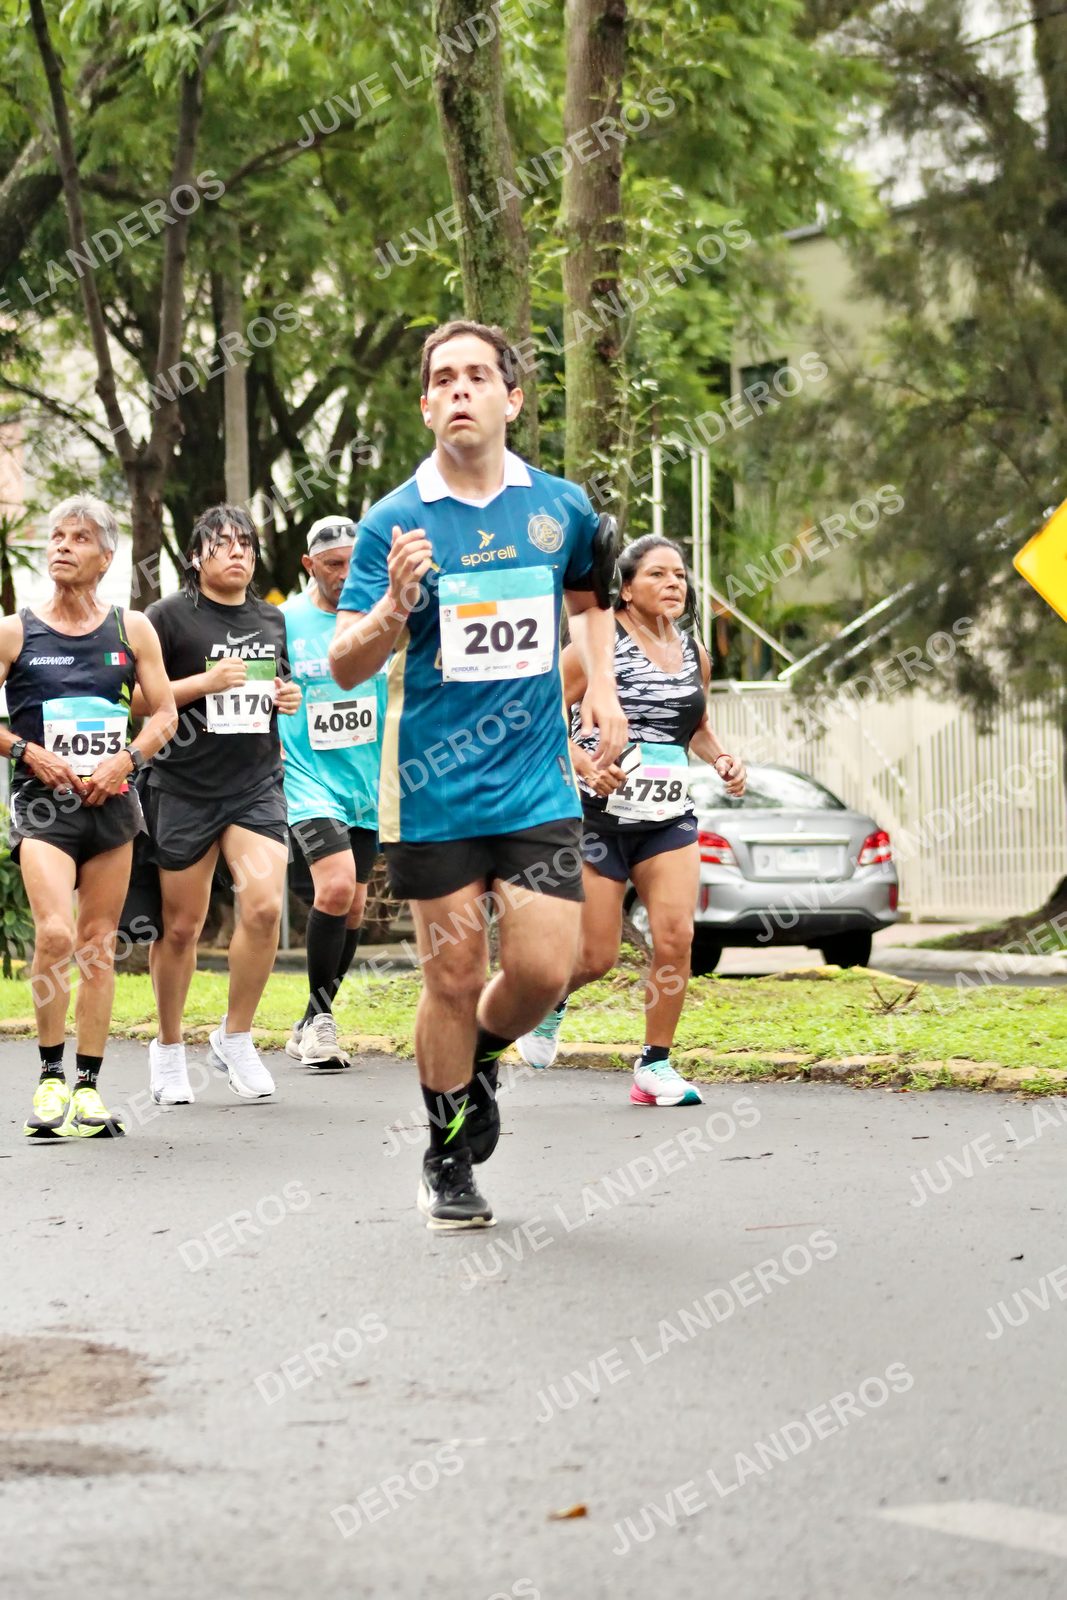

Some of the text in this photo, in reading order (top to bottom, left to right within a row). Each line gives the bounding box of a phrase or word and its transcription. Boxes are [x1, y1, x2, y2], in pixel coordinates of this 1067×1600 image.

[461, 545, 517, 567] sporelli
[463, 618, 539, 655] 202
[213, 694, 273, 716] 1170
[314, 709, 372, 733] 4080
[52, 732, 121, 757] 4053
[615, 778, 683, 803] 4738
